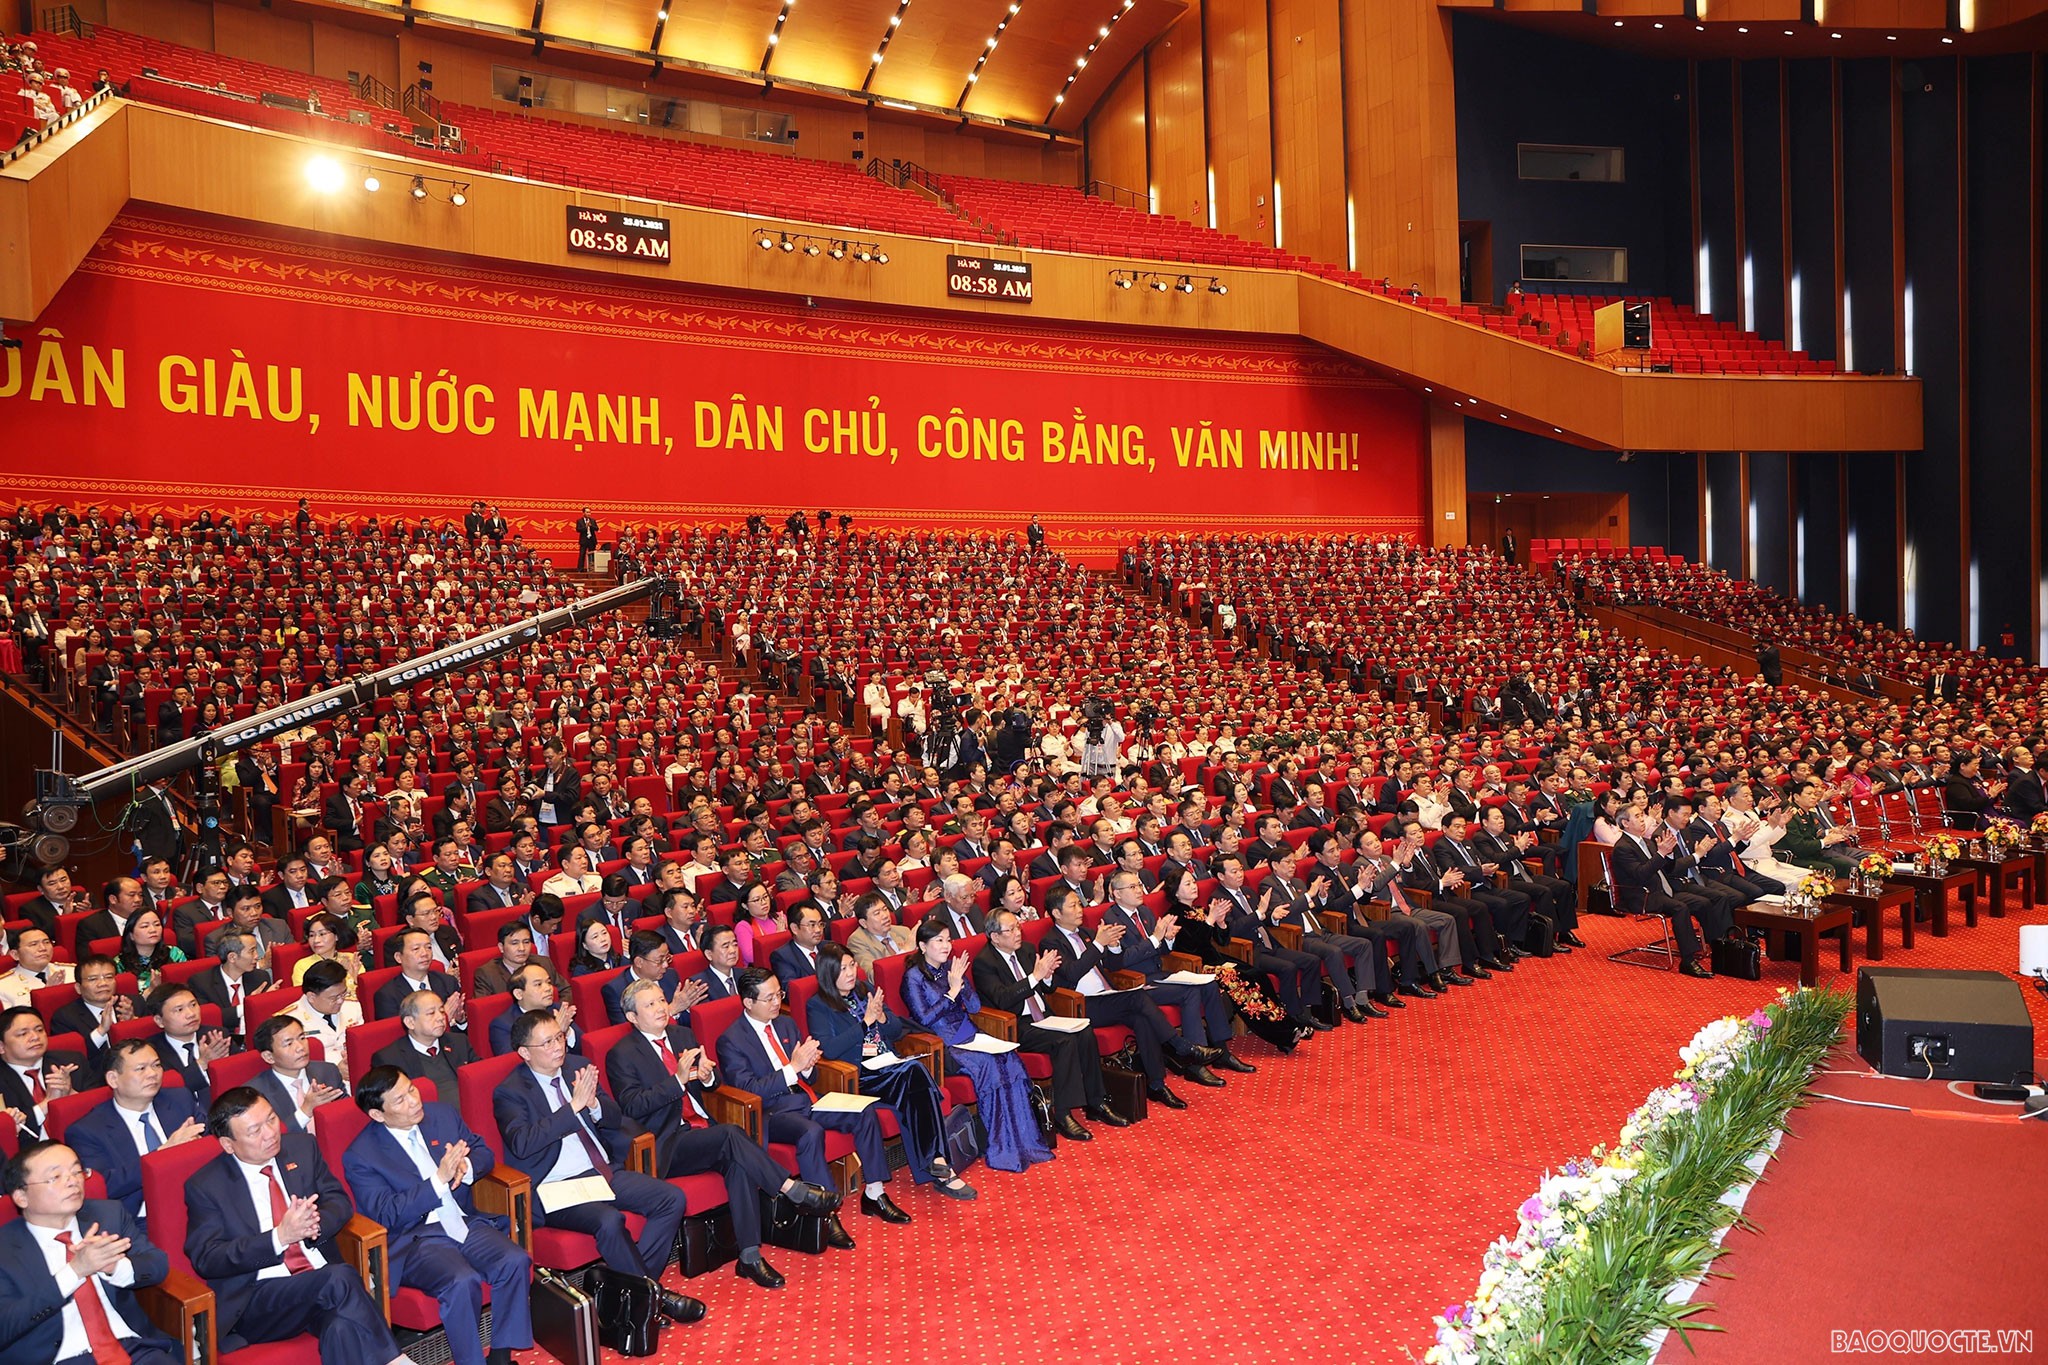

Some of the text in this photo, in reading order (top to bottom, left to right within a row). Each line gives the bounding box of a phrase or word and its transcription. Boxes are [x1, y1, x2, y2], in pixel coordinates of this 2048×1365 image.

[579, 211, 607, 223] HÀ NỘI
[570, 228, 669, 258] 08:58 AM
[958, 259, 968, 268] HÀ
[951, 274, 1031, 298] 08:58 AM
[159, 349, 319, 434] GIÀU,
[348, 368, 495, 435] NƯỚC
[519, 388, 673, 455] MẠNH,
[695, 393, 783, 451] DÂN
[804, 396, 898, 464] CHỦ,
[917, 408, 1025, 462] CÔNG
[1042, 406, 1155, 472] BẰNG,
[1171, 421, 1243, 469] VĂN
[1259, 430, 1359, 471] MINH!
[223, 635, 512, 746] SCANNER EGRIPMENT
